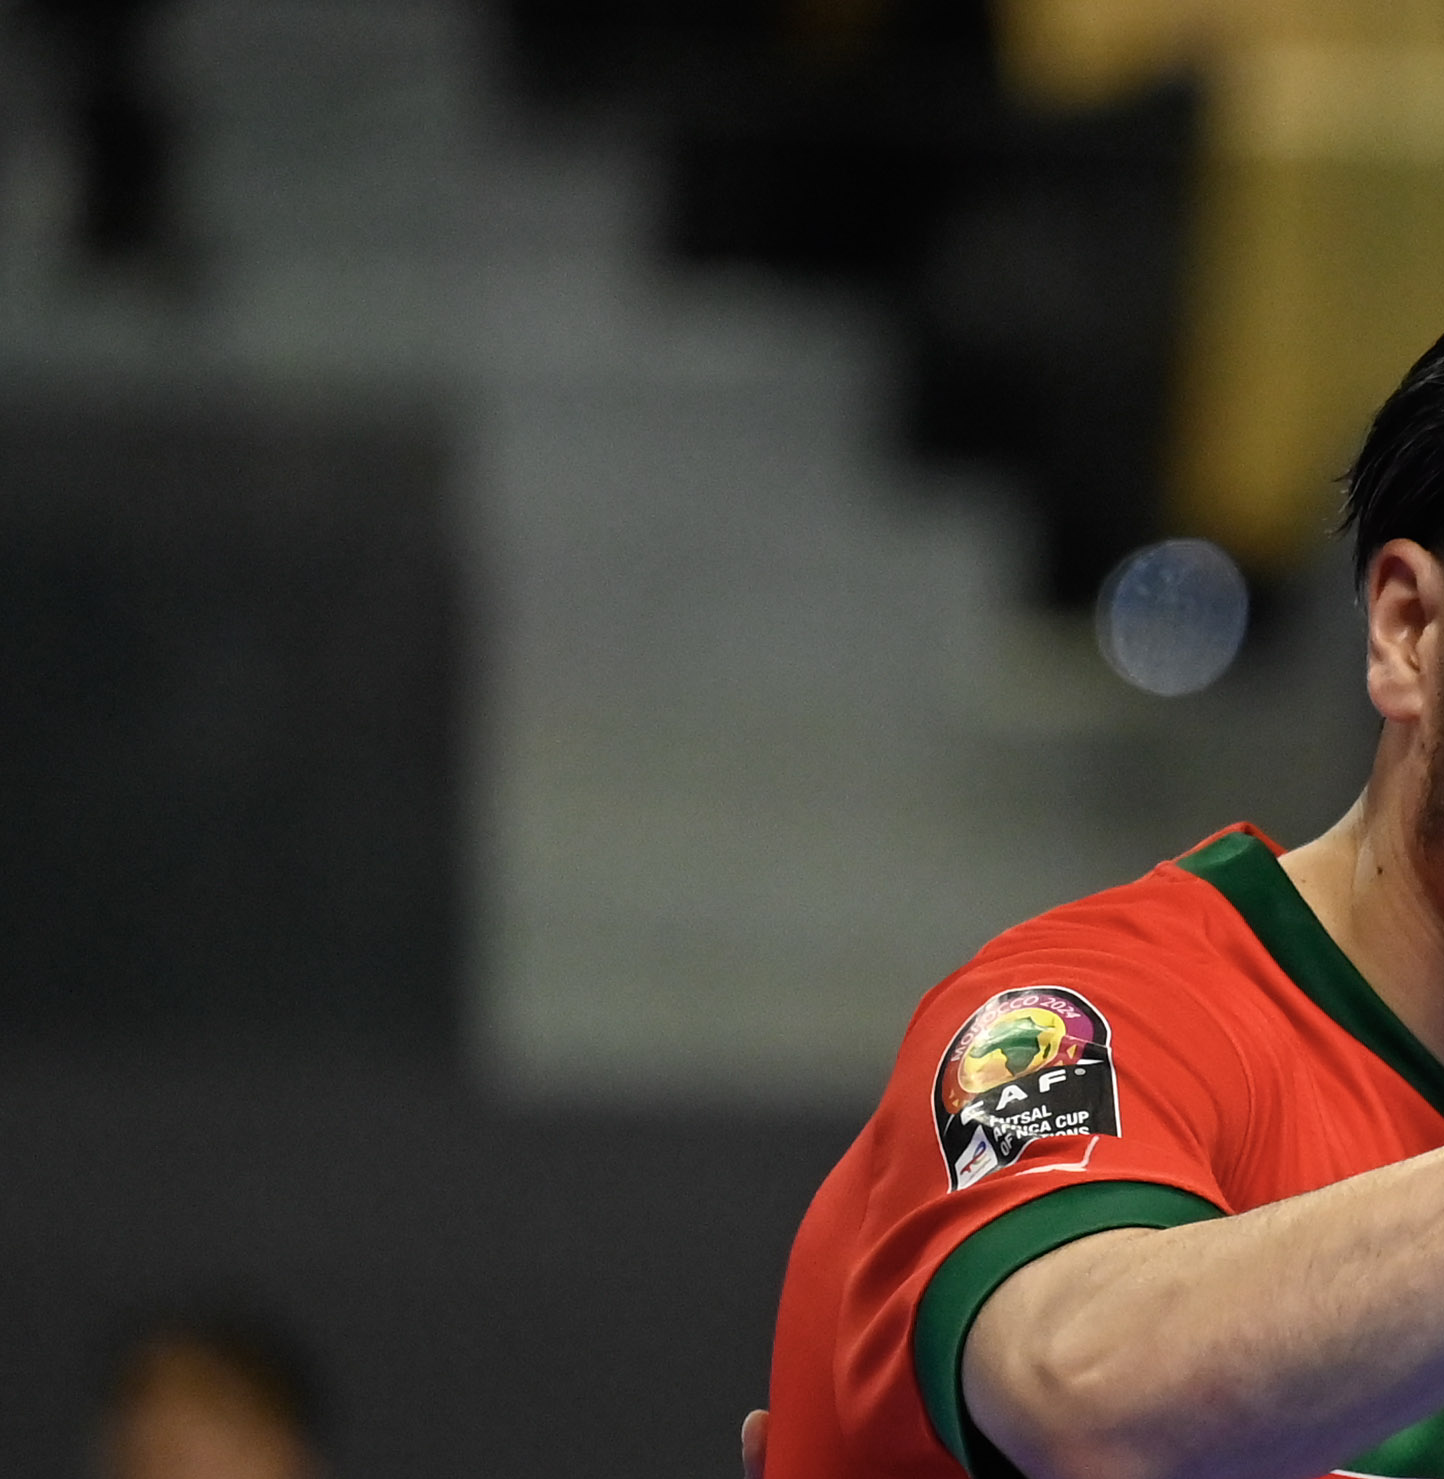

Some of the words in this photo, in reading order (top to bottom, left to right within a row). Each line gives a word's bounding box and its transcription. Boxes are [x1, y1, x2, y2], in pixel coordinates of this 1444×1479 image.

[950, 995, 1040, 1062] MOROCCO
[1040, 997, 1081, 1019] 2024
[1055, 1111, 1090, 1128] CUP
[1000, 1133, 1014, 1156] OF
